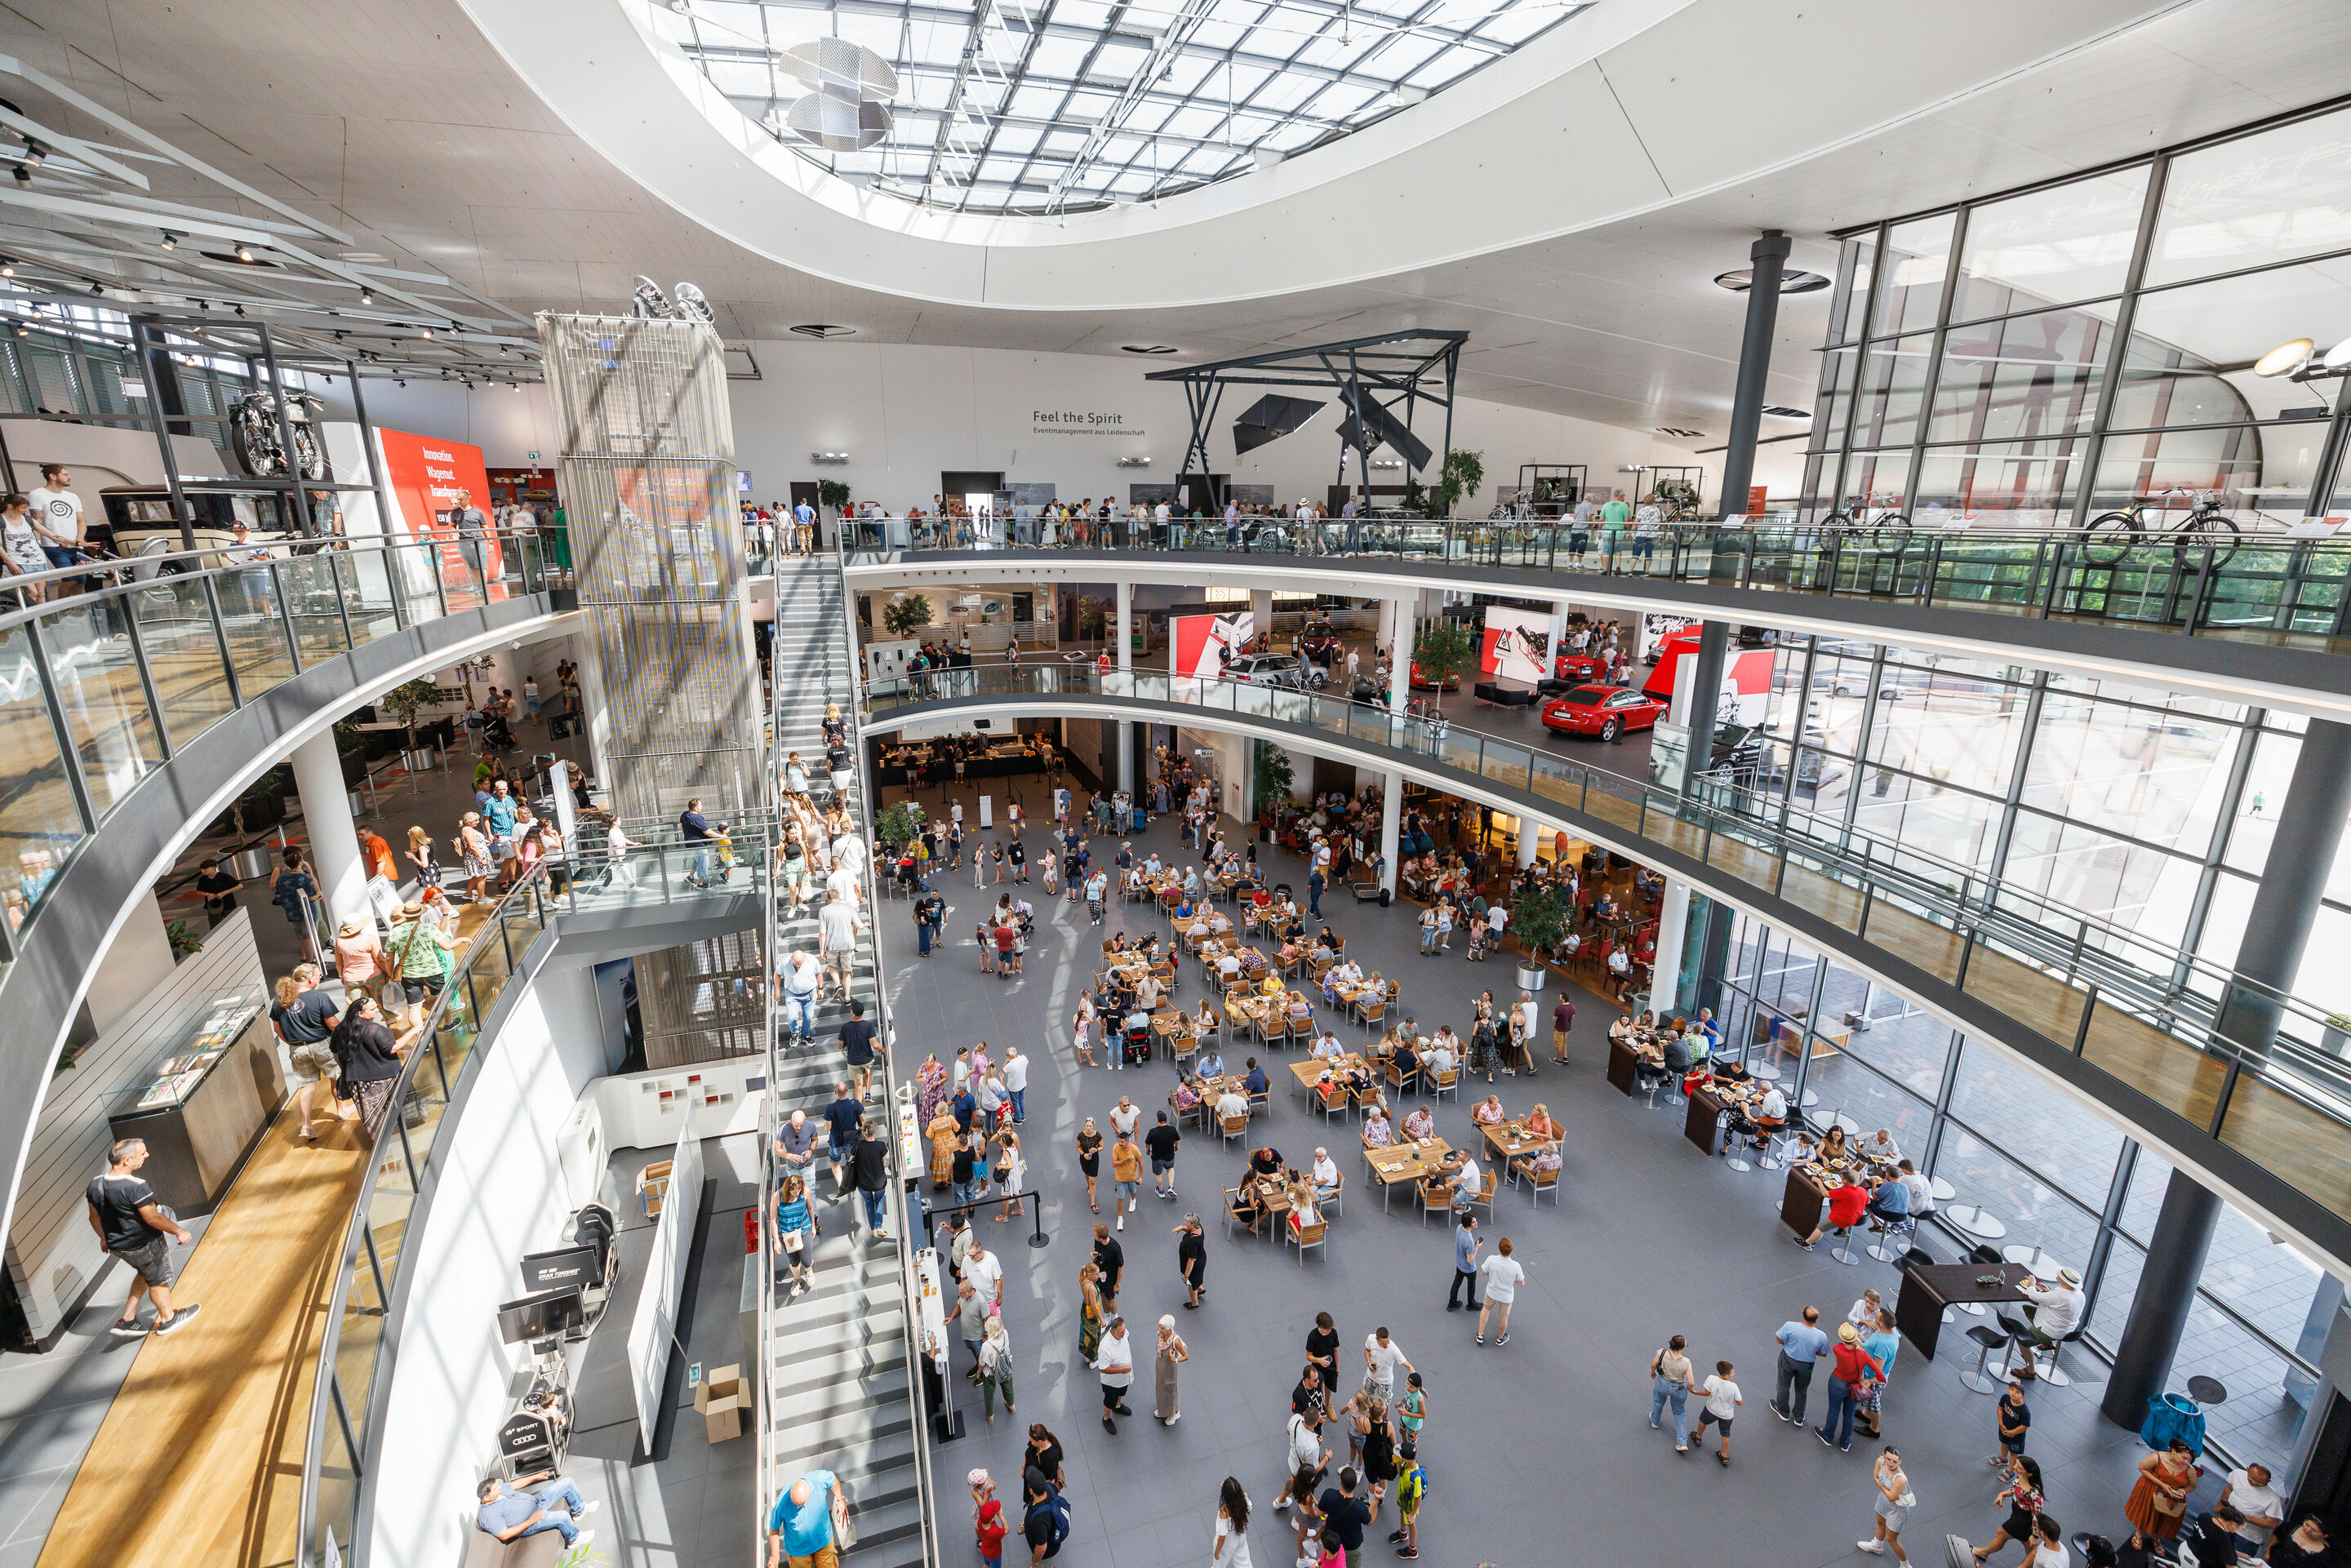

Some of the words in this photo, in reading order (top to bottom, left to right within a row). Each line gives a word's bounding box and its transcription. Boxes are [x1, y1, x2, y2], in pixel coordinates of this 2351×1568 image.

[247, 409, 263, 427] 31
[1033, 411, 1059, 422] Feel
[1063, 411, 1083, 423] the
[1087, 412, 1122, 426] Spirit
[1033, 427, 1093, 436] Eventmanagement
[422, 446, 455, 463] Innovation.
[425, 464, 456, 482] Wagemut.
[538, 1273, 553, 1281] GRAN
[516, 1422, 539, 1433] SPORT
